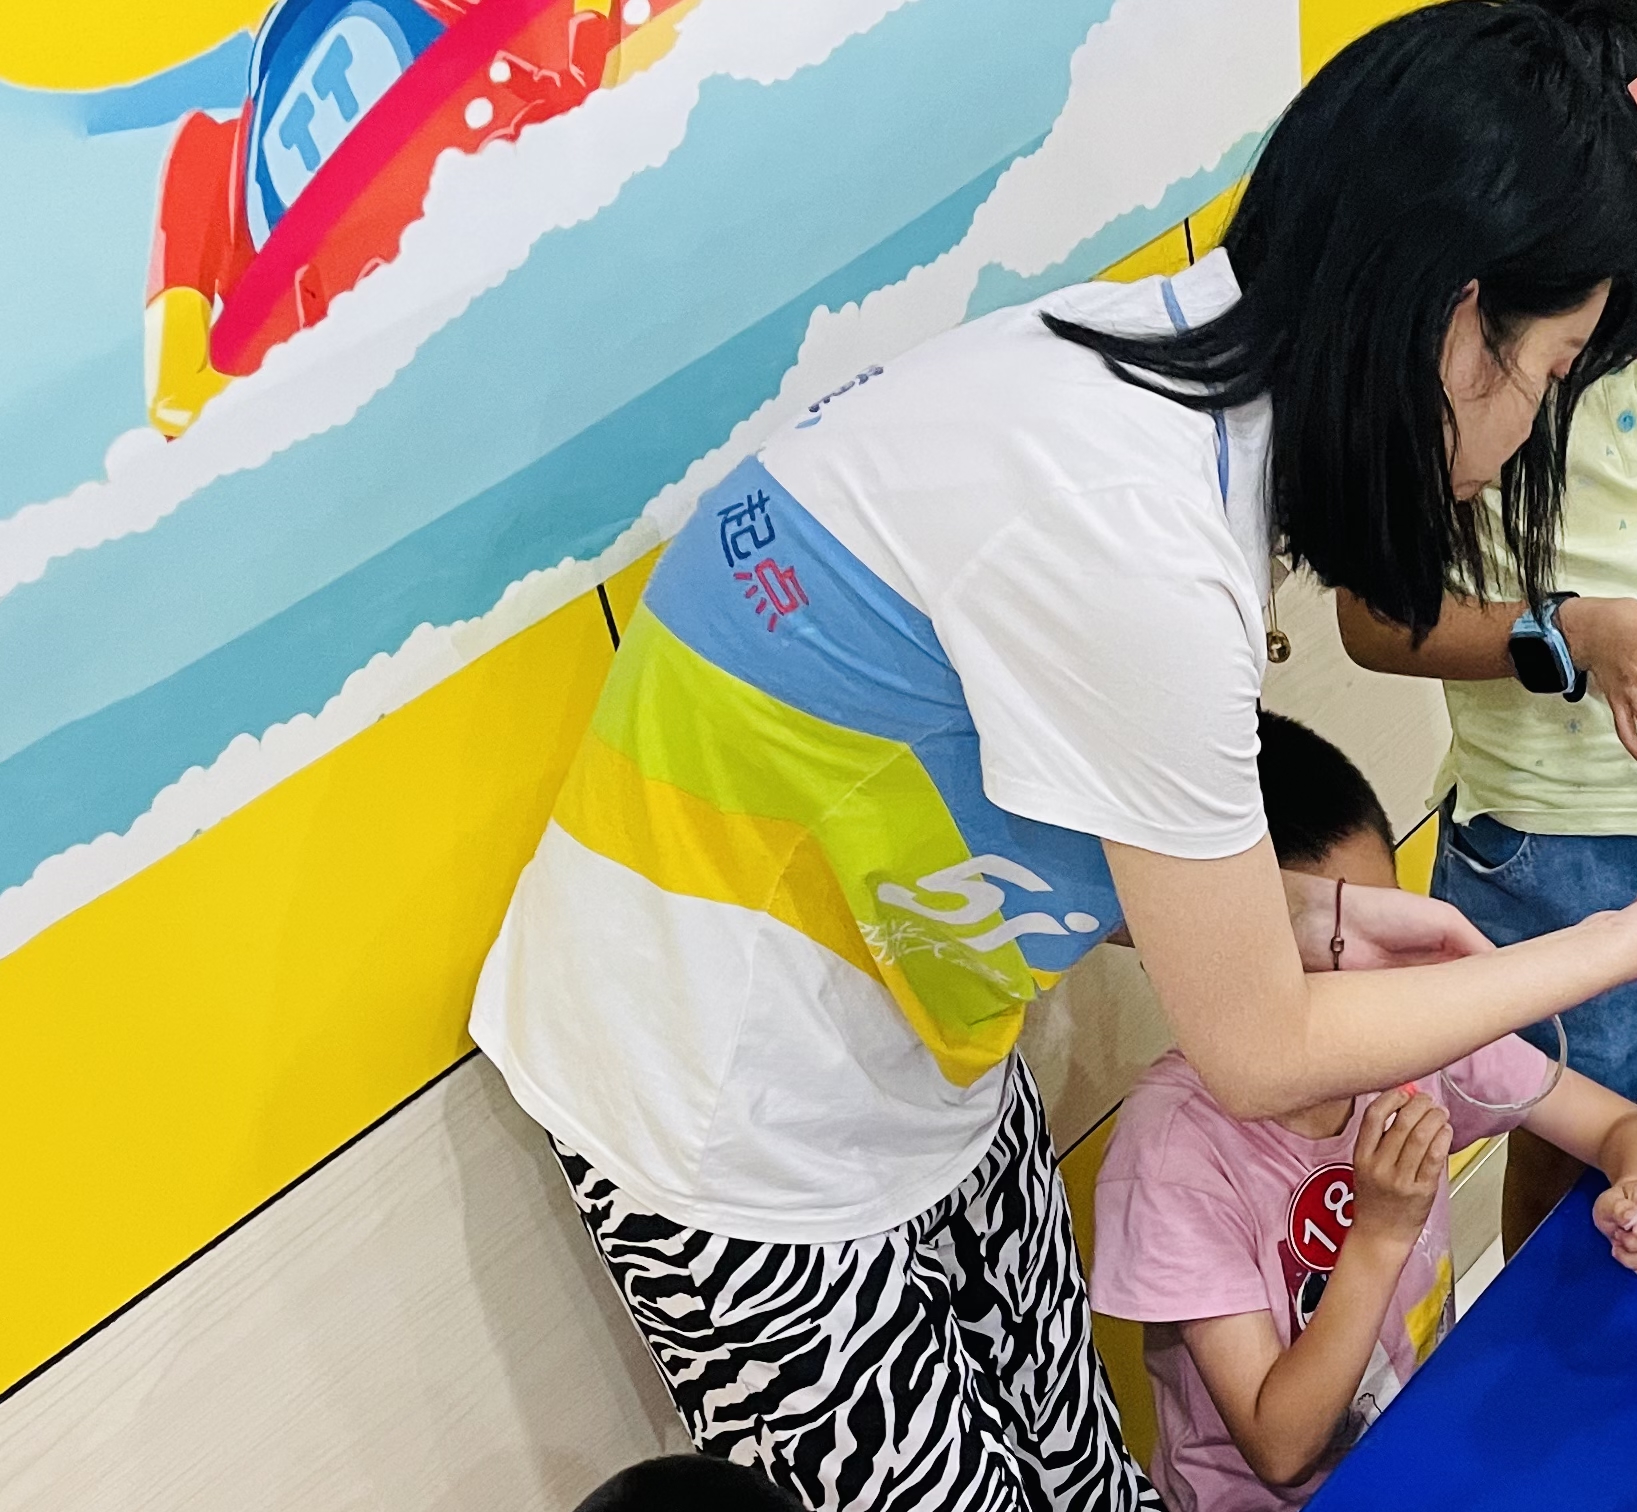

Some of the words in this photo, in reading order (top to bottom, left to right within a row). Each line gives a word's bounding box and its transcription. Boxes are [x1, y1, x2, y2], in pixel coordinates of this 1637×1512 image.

[278, 34, 360, 171] TT
[716, 489, 810, 633] 起点
[1303, 1180, 1354, 1253] 18
